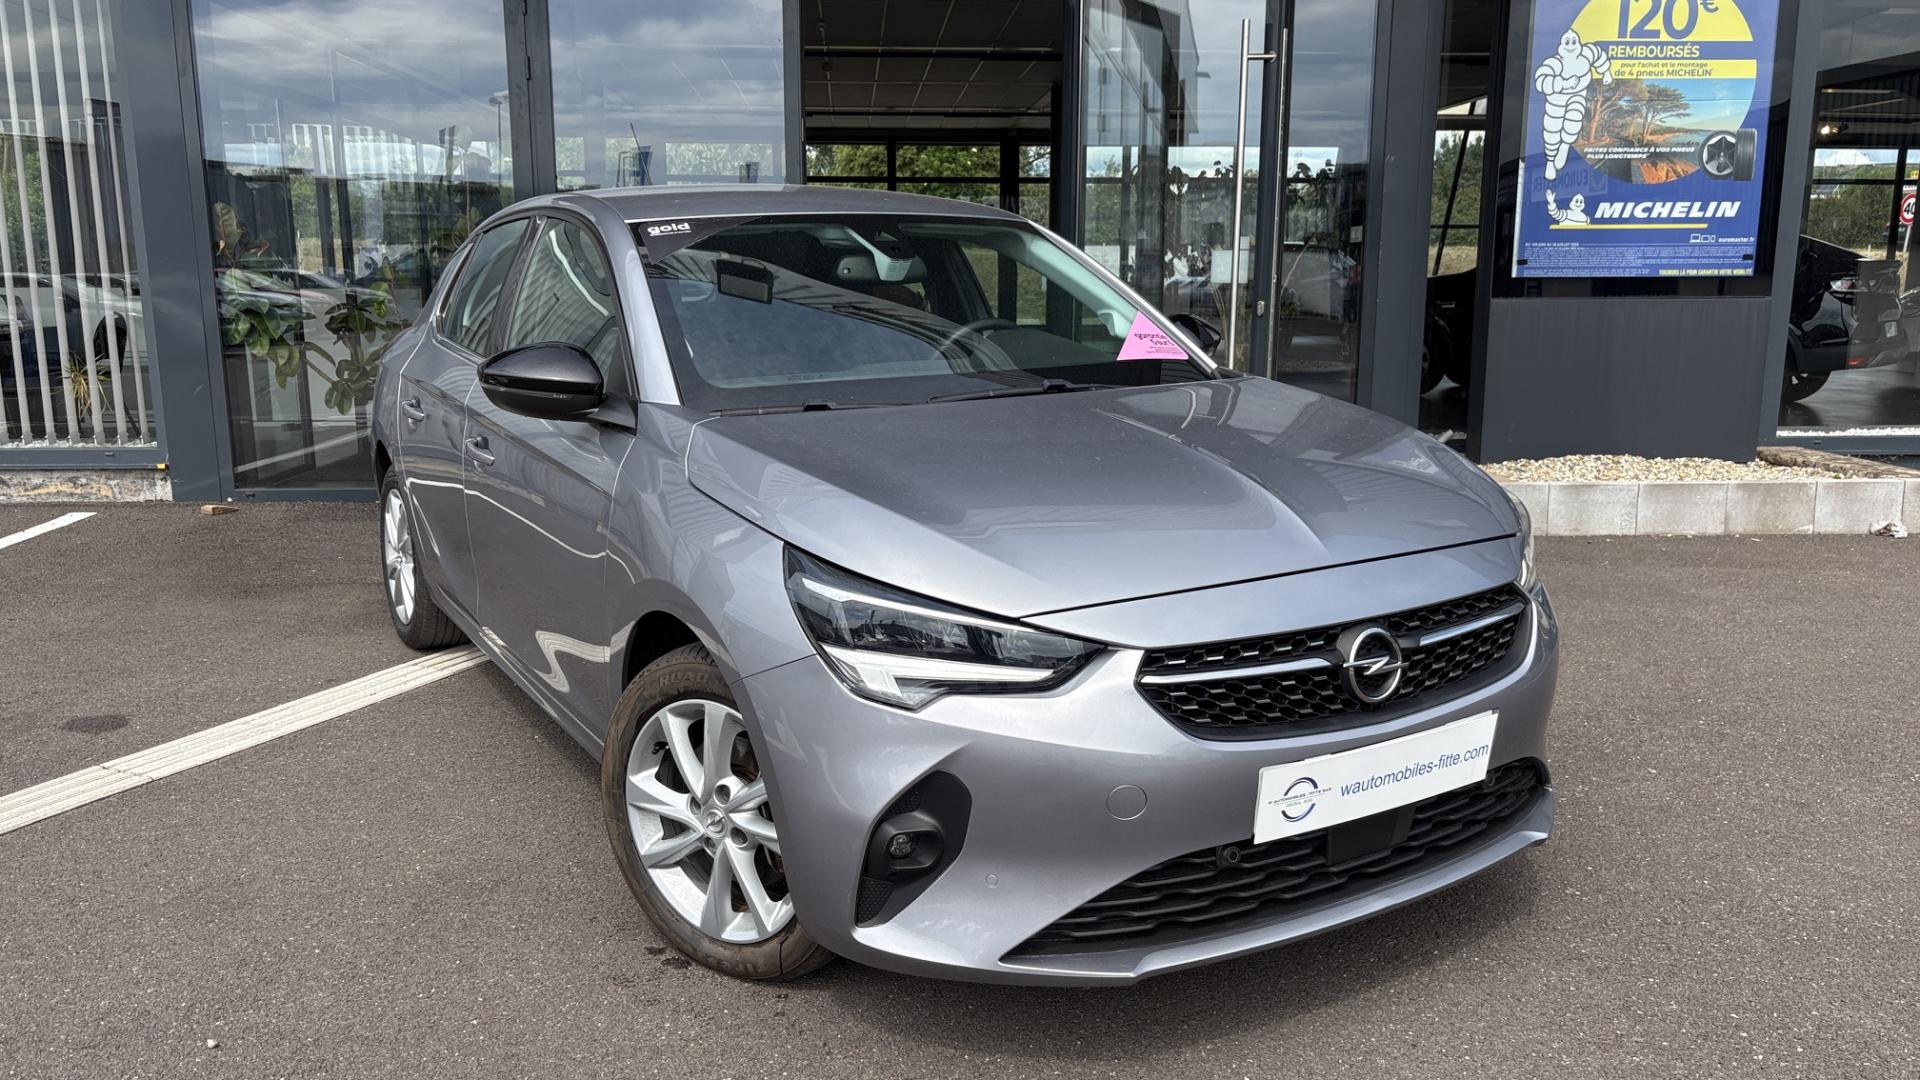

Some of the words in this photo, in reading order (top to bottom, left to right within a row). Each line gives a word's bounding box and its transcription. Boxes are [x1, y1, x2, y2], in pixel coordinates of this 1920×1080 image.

[1608, 43, 1700, 58] REMBOURSÉS
[1614, 69, 1626, 77] de
[1627, 69, 1634, 77] 4
[1635, 70, 1664, 79] pneus
[1594, 201, 1741, 219] MICHELIN
[647, 222, 690, 237] gold
[1340, 744, 1489, 797] wautomobiles-fitte.com
